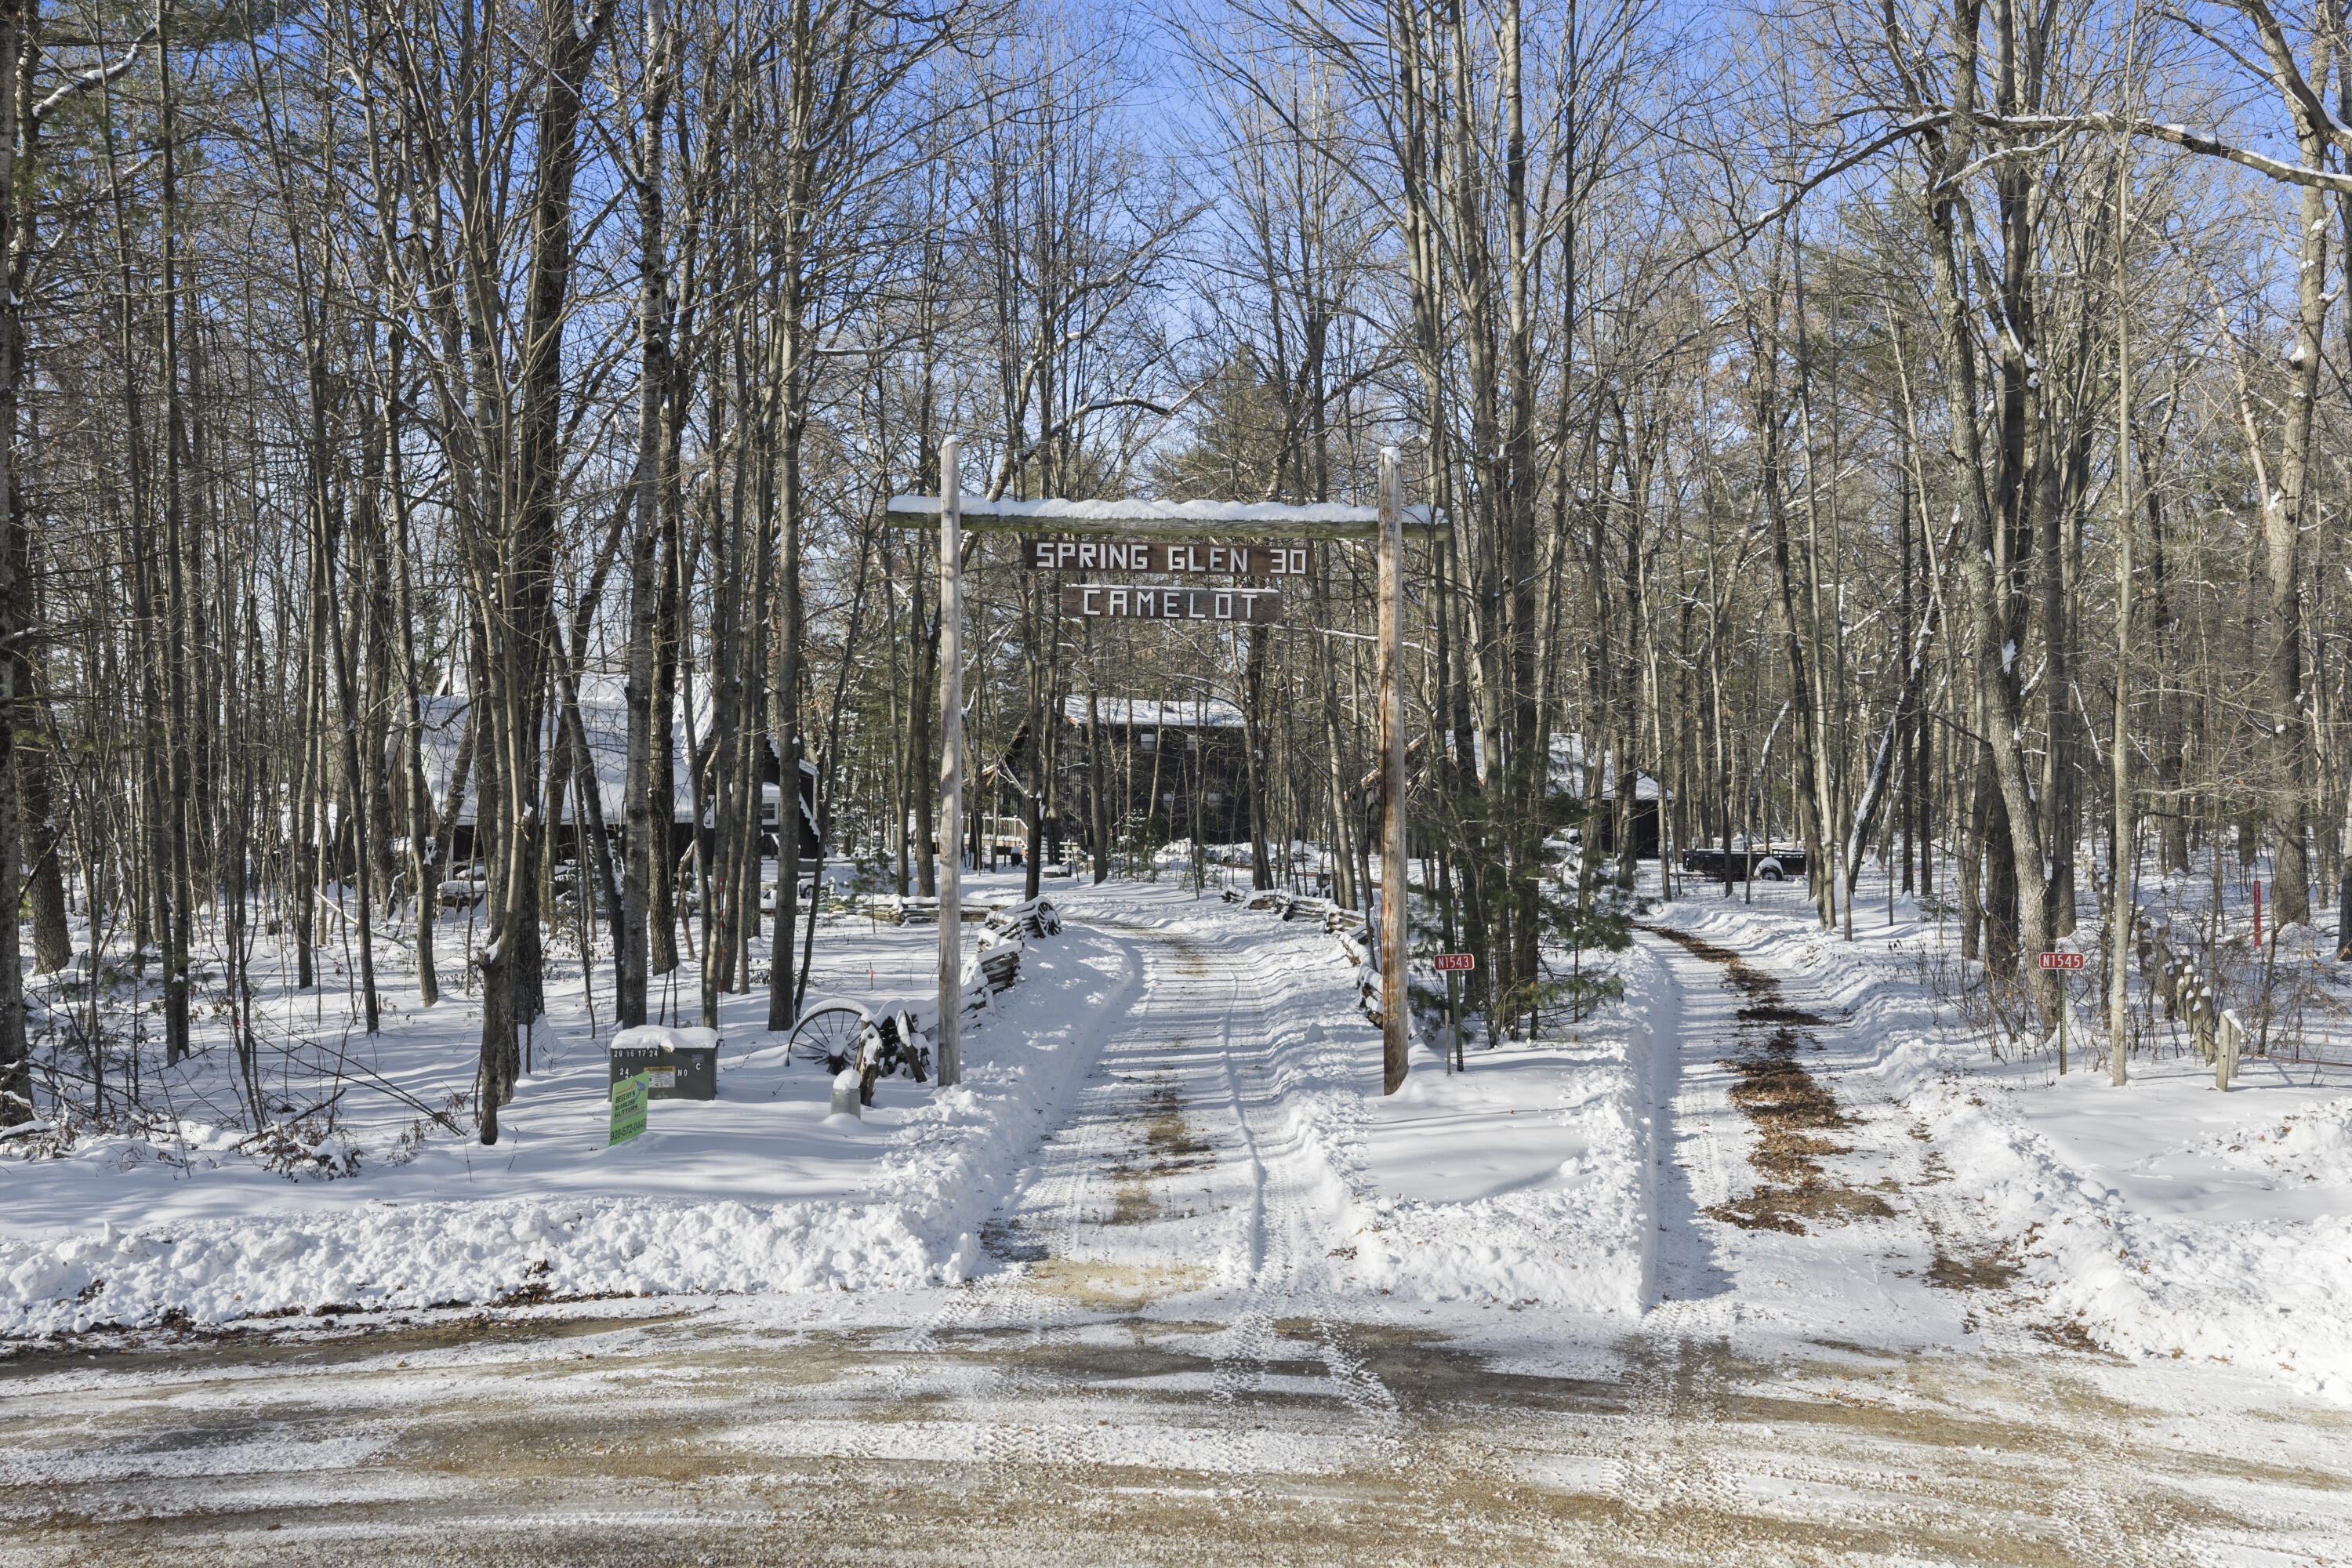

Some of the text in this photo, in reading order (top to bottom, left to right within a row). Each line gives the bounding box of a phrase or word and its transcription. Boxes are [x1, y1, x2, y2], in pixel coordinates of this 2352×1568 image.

[1036, 543, 1306, 575] SPRING GLEN 30
[1083, 590, 1258, 619] CAMELOT
[1438, 956, 1469, 969] N1543
[2043, 955, 2080, 968] N1545
[614, 1105, 638, 1118] GUTTERS
[615, 1099, 636, 1111] SEAMLESS
[610, 1118, 647, 1141] 920-572-0443
